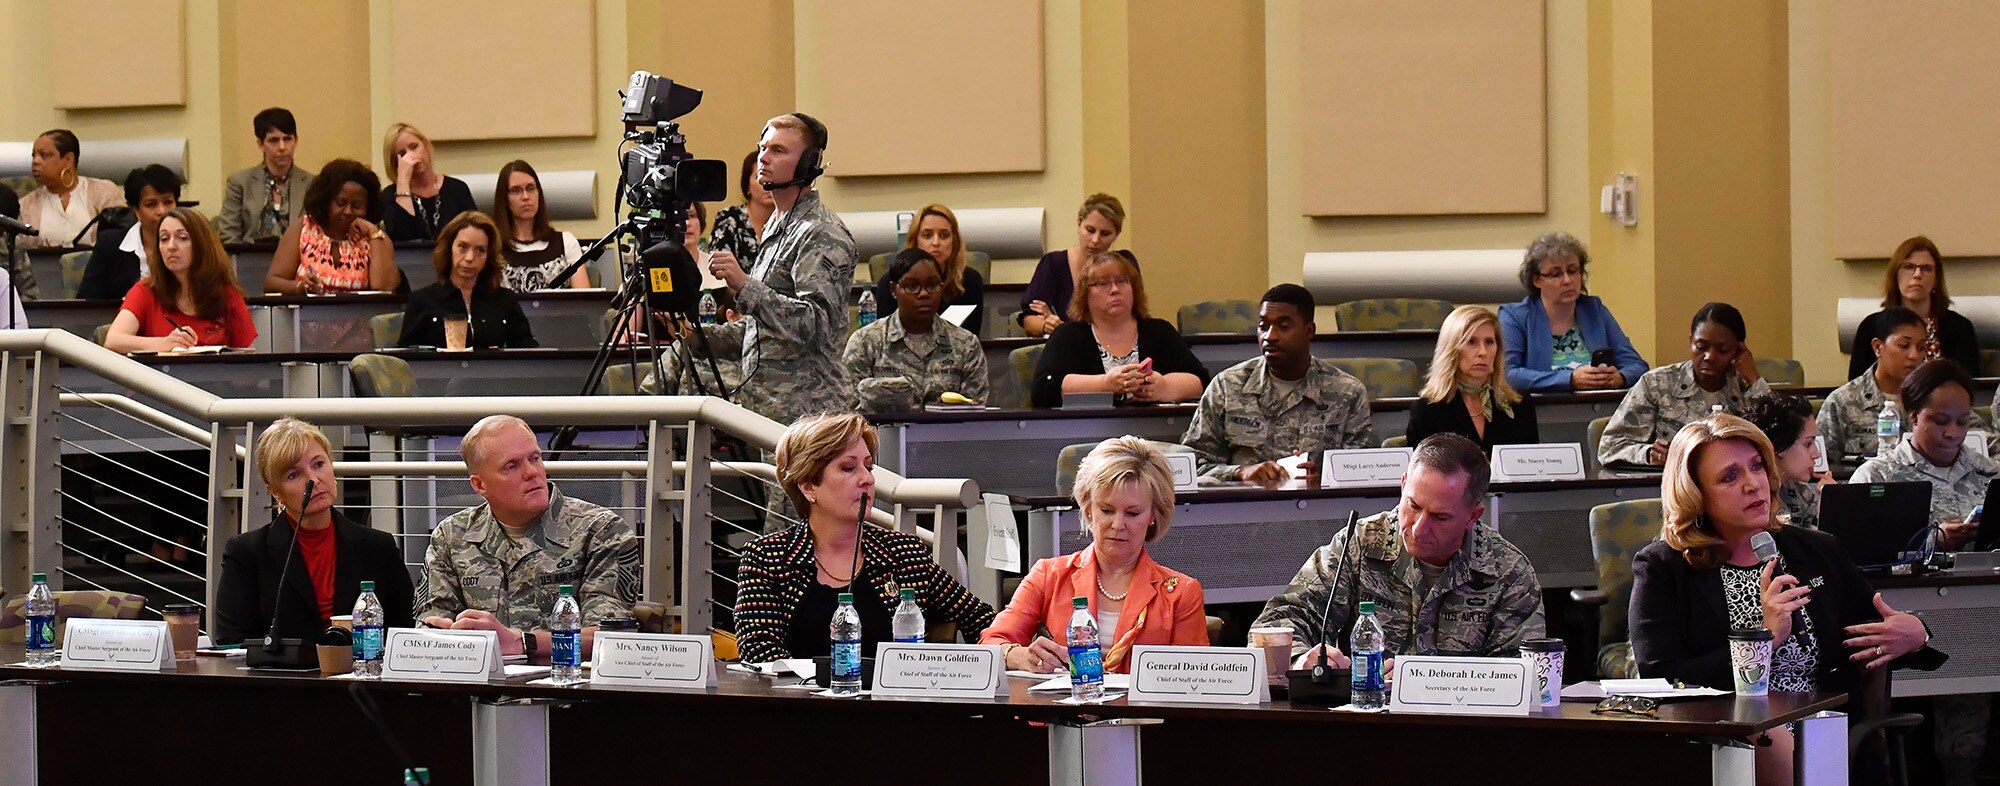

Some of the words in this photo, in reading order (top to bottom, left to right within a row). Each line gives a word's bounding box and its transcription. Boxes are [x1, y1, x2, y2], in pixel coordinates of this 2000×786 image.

[635, 73, 641, 86] 3
[463, 576, 479, 586] CODY
[1461, 611, 1474, 622] AIR
[403, 639, 433, 648] CMSAF
[433, 640, 456, 649] James
[457, 640, 476, 651] Cody
[615, 642, 633, 651] Mrs.
[636, 643, 660, 654] Nancy
[661, 644, 688, 653] Wilson
[424, 654, 443, 662] Sergeant
[898, 652, 917, 661] Mrs.
[919, 653, 942, 662] Dawn
[944, 653, 980, 663] Goldfein
[1146, 661, 1181, 671] General
[1182, 661, 1208, 672] David
[1210, 662, 1248, 672] Goldfein
[1408, 668, 1426, 678] Ms.
[1428, 668, 1467, 679] Deborah
[1470, 669, 1487, 680] Lee
[1488, 670, 1518, 680] James
